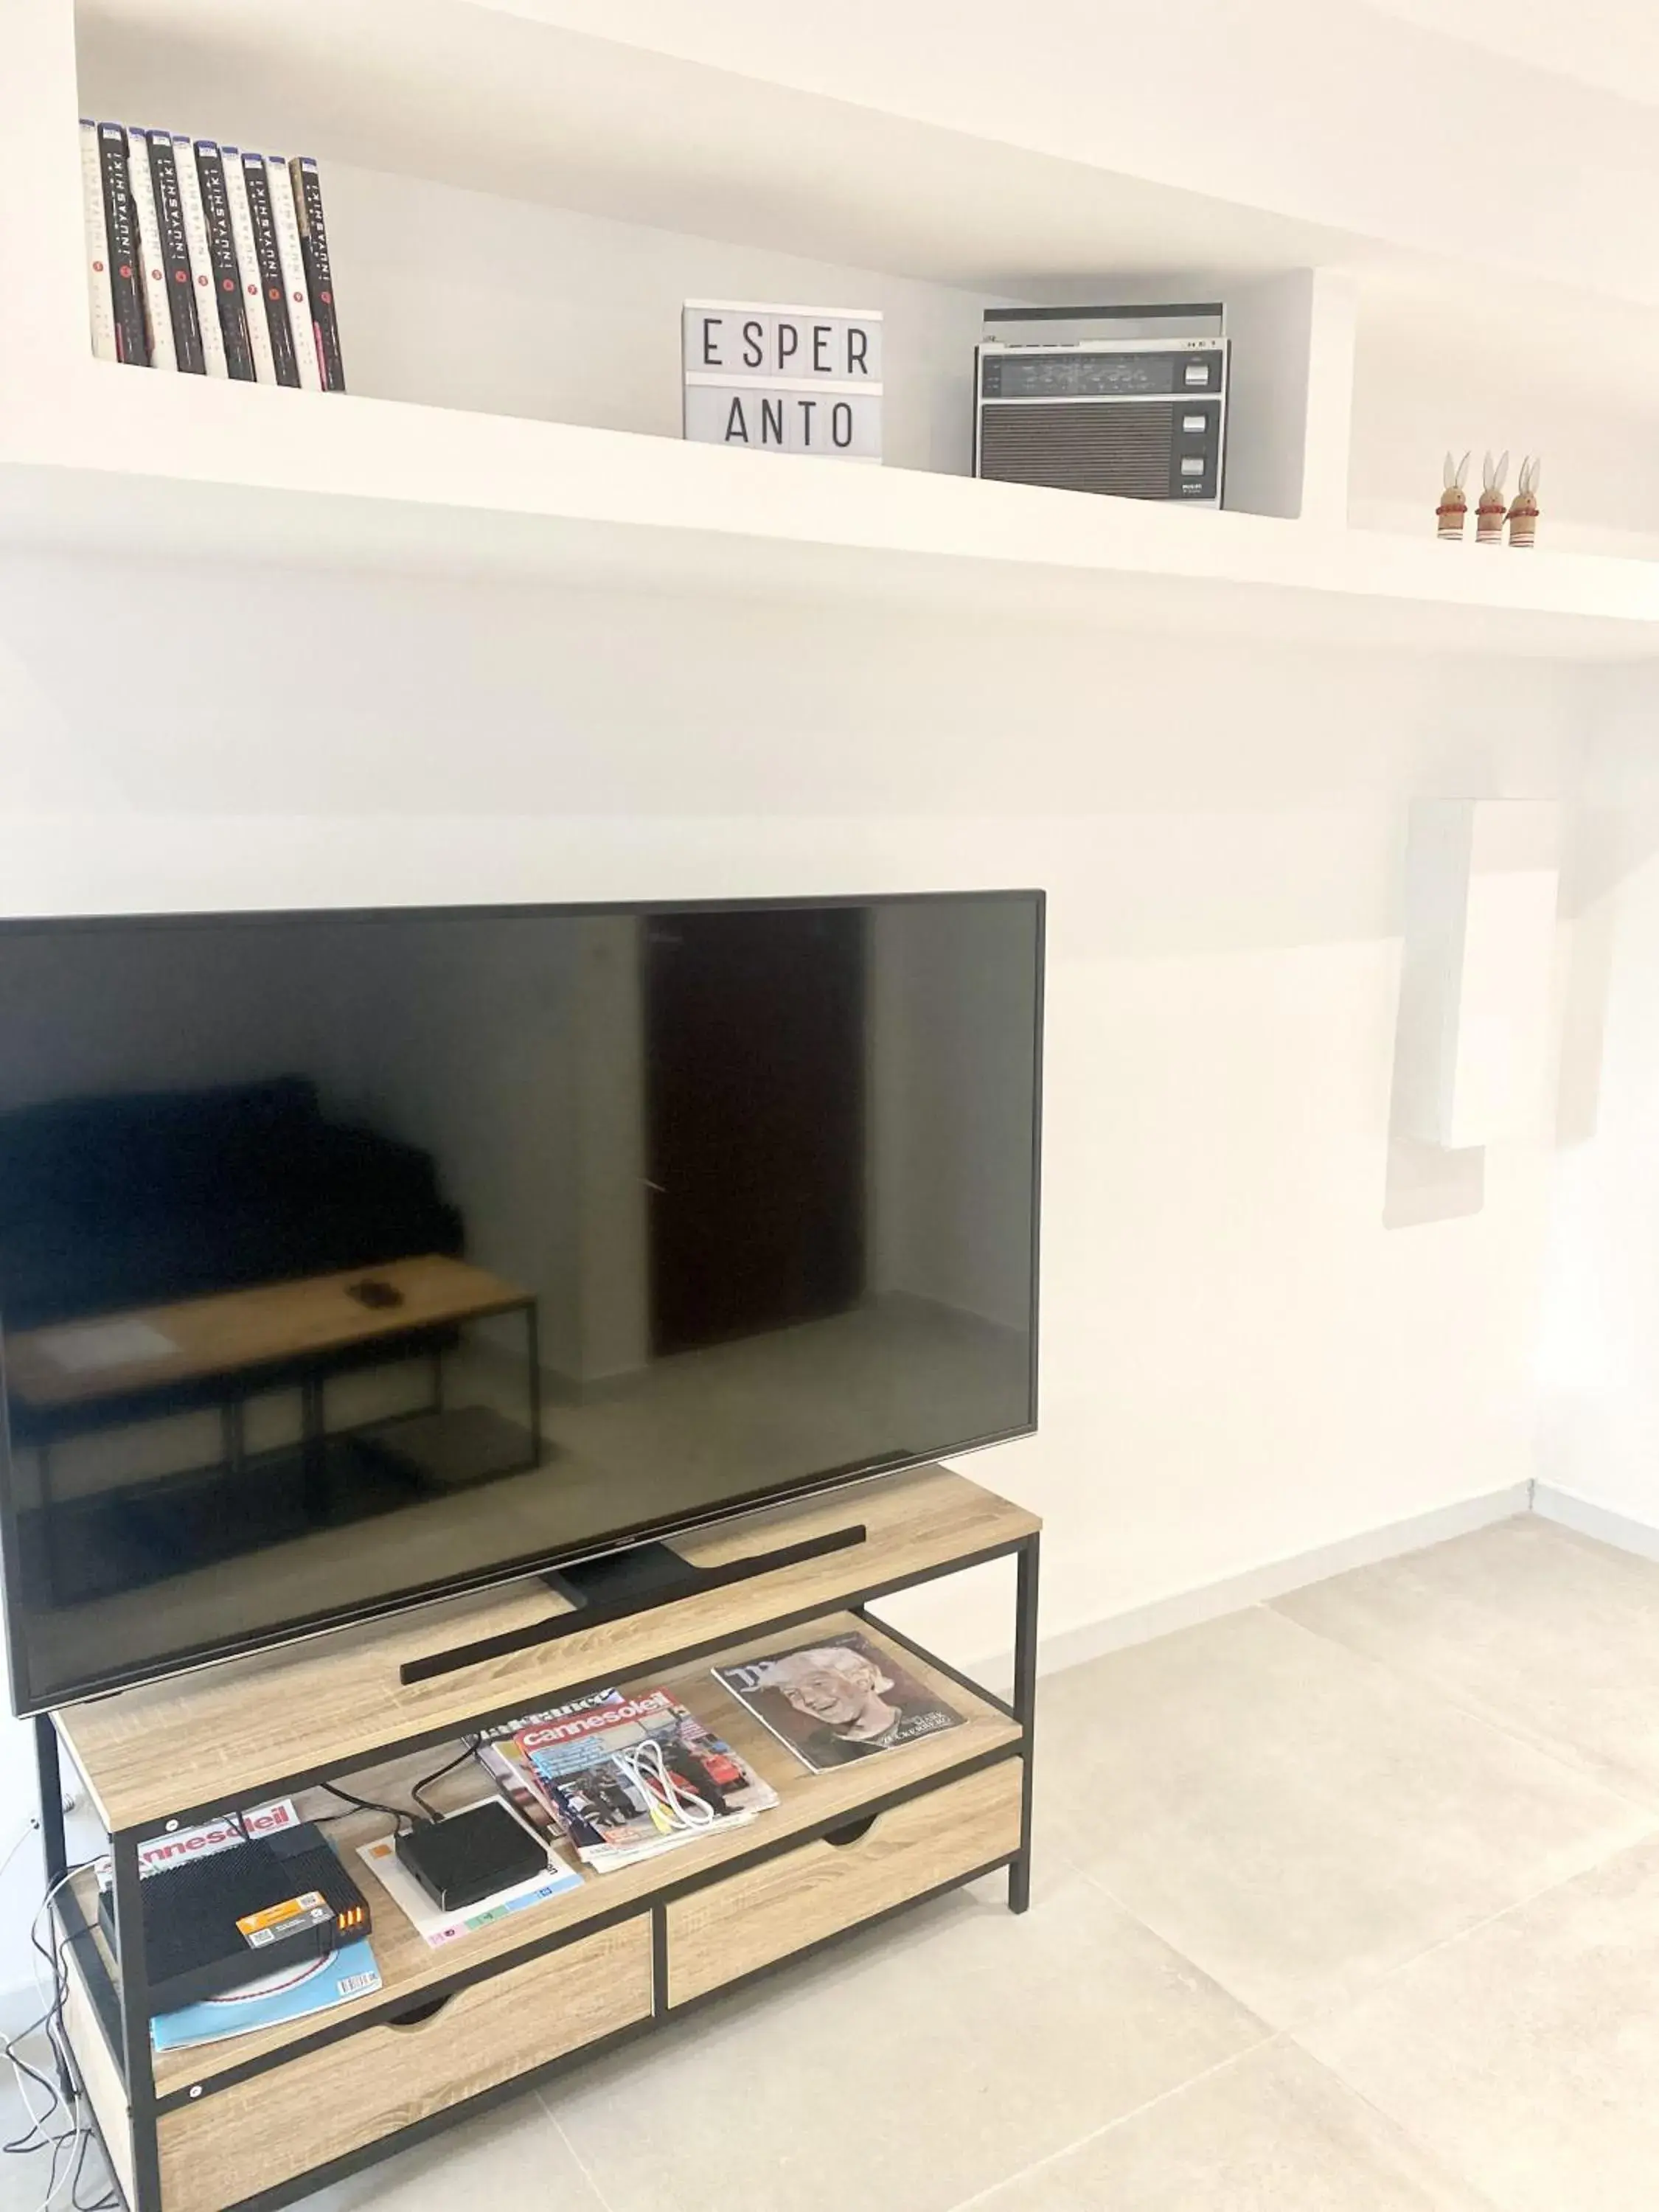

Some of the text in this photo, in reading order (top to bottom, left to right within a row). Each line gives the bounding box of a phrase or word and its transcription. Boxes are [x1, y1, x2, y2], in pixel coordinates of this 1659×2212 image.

[114, 153, 130, 254] INUYASHIKI
[164, 159, 184, 260] INUYASHIKI
[210, 170, 232, 268] INUYASHIKI
[256, 181, 278, 278] INUYASHIKI
[312, 185, 329, 281] INUYASHIKI
[703, 318, 868, 374] ESPER
[725, 397, 852, 448] ANTO
[98, 1805, 290, 1875] nnesoleil
